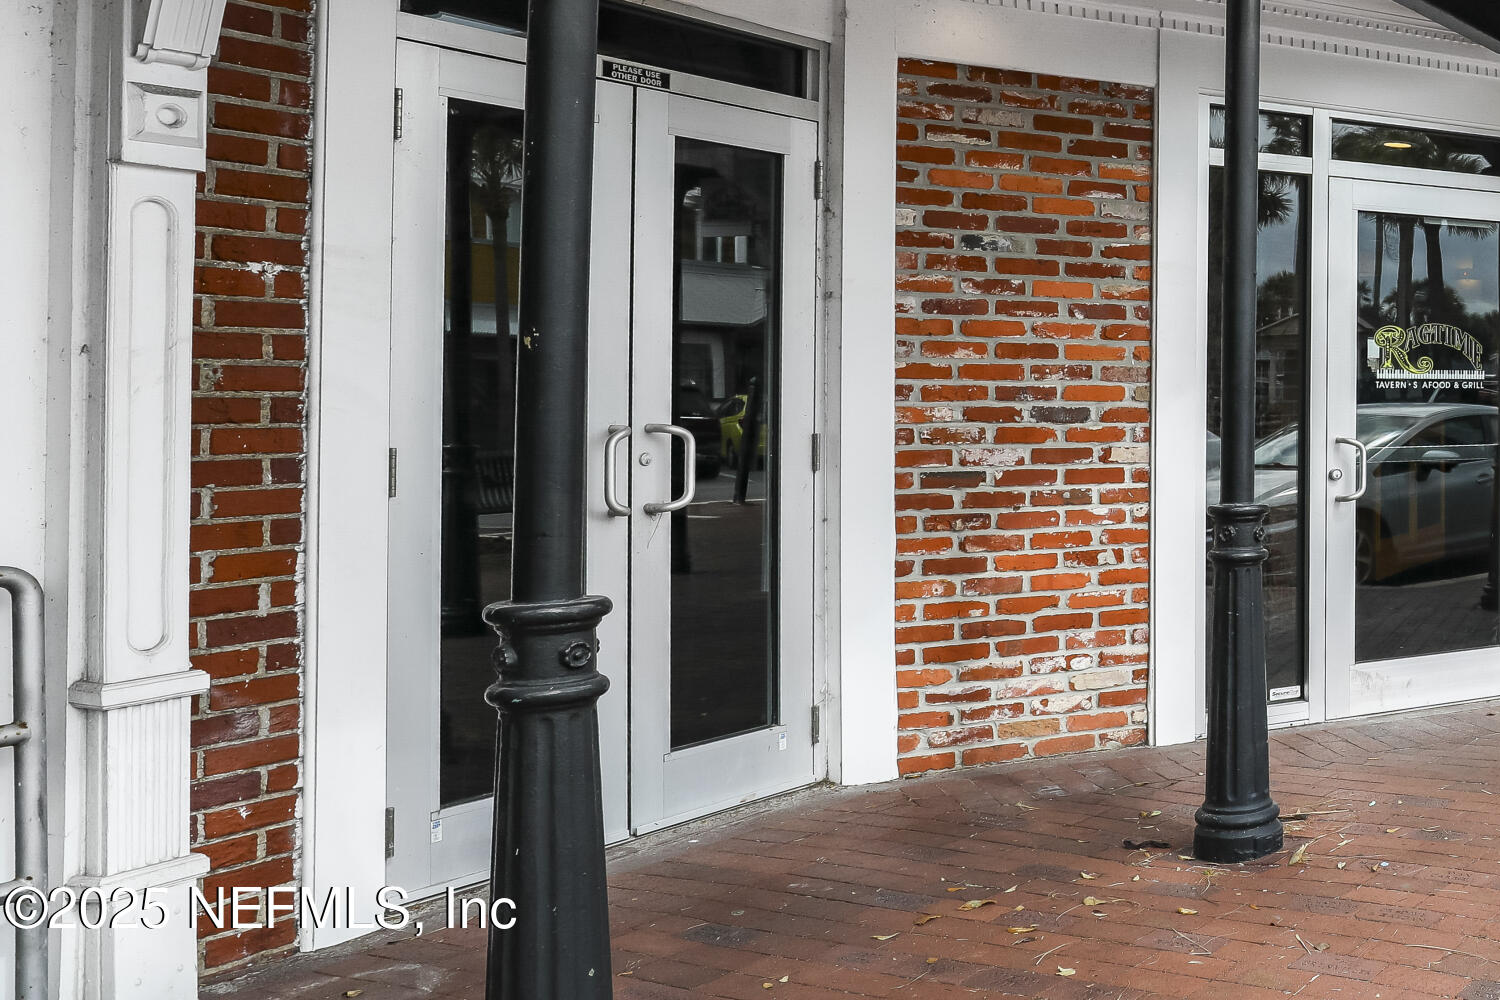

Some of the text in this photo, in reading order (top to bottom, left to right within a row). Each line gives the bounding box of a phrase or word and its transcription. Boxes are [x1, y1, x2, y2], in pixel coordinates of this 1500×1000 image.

[611, 70, 662, 87] OTHER DOOR
[612, 63, 661, 80] PLEASE USE
[1373, 322, 1483, 374] RAGTIME
[1375, 381, 1407, 389] TAVERN
[1454, 381, 1460, 389] &
[1461, 381, 1485, 389] GRILL
